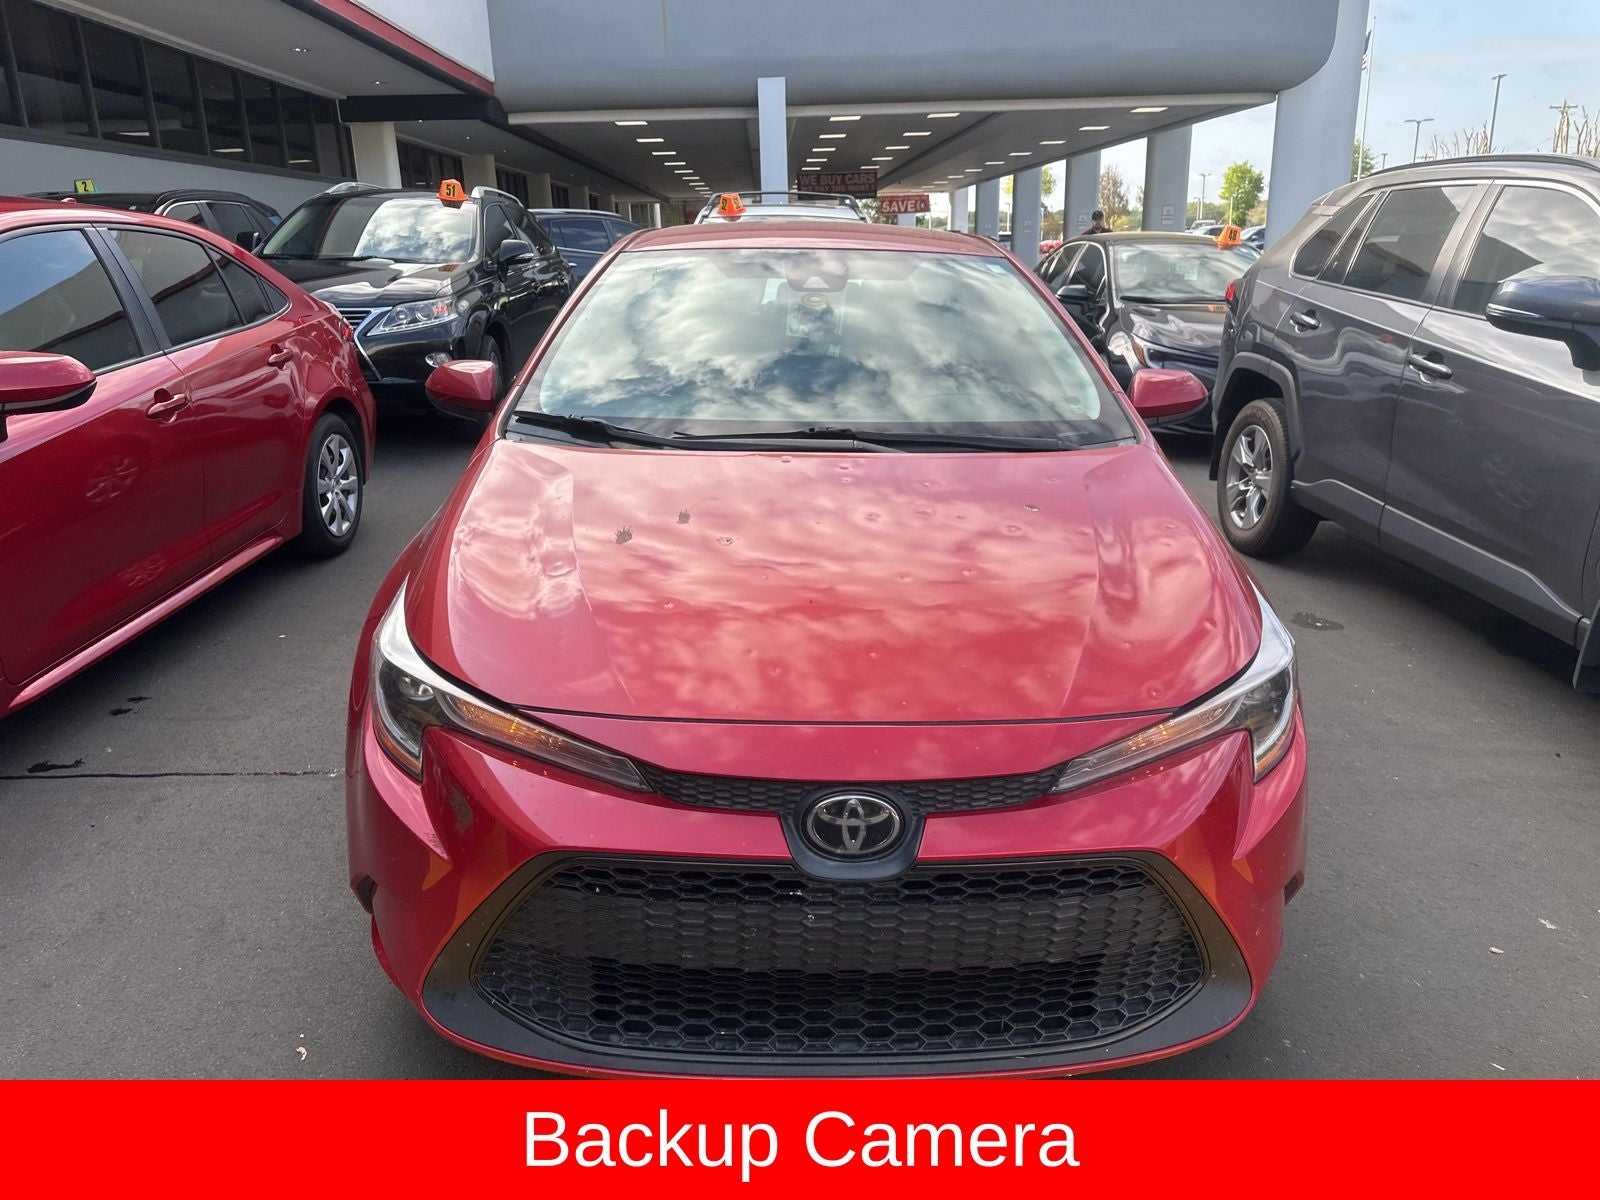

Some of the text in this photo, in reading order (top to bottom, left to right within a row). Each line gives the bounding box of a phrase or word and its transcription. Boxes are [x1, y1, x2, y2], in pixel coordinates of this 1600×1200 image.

[800, 173, 875, 185] WE BUY CARS
[81, 181, 89, 192] 2
[446, 183, 456, 197] 51
[881, 200, 915, 213] SAVE
[1228, 229, 1238, 241] 48
